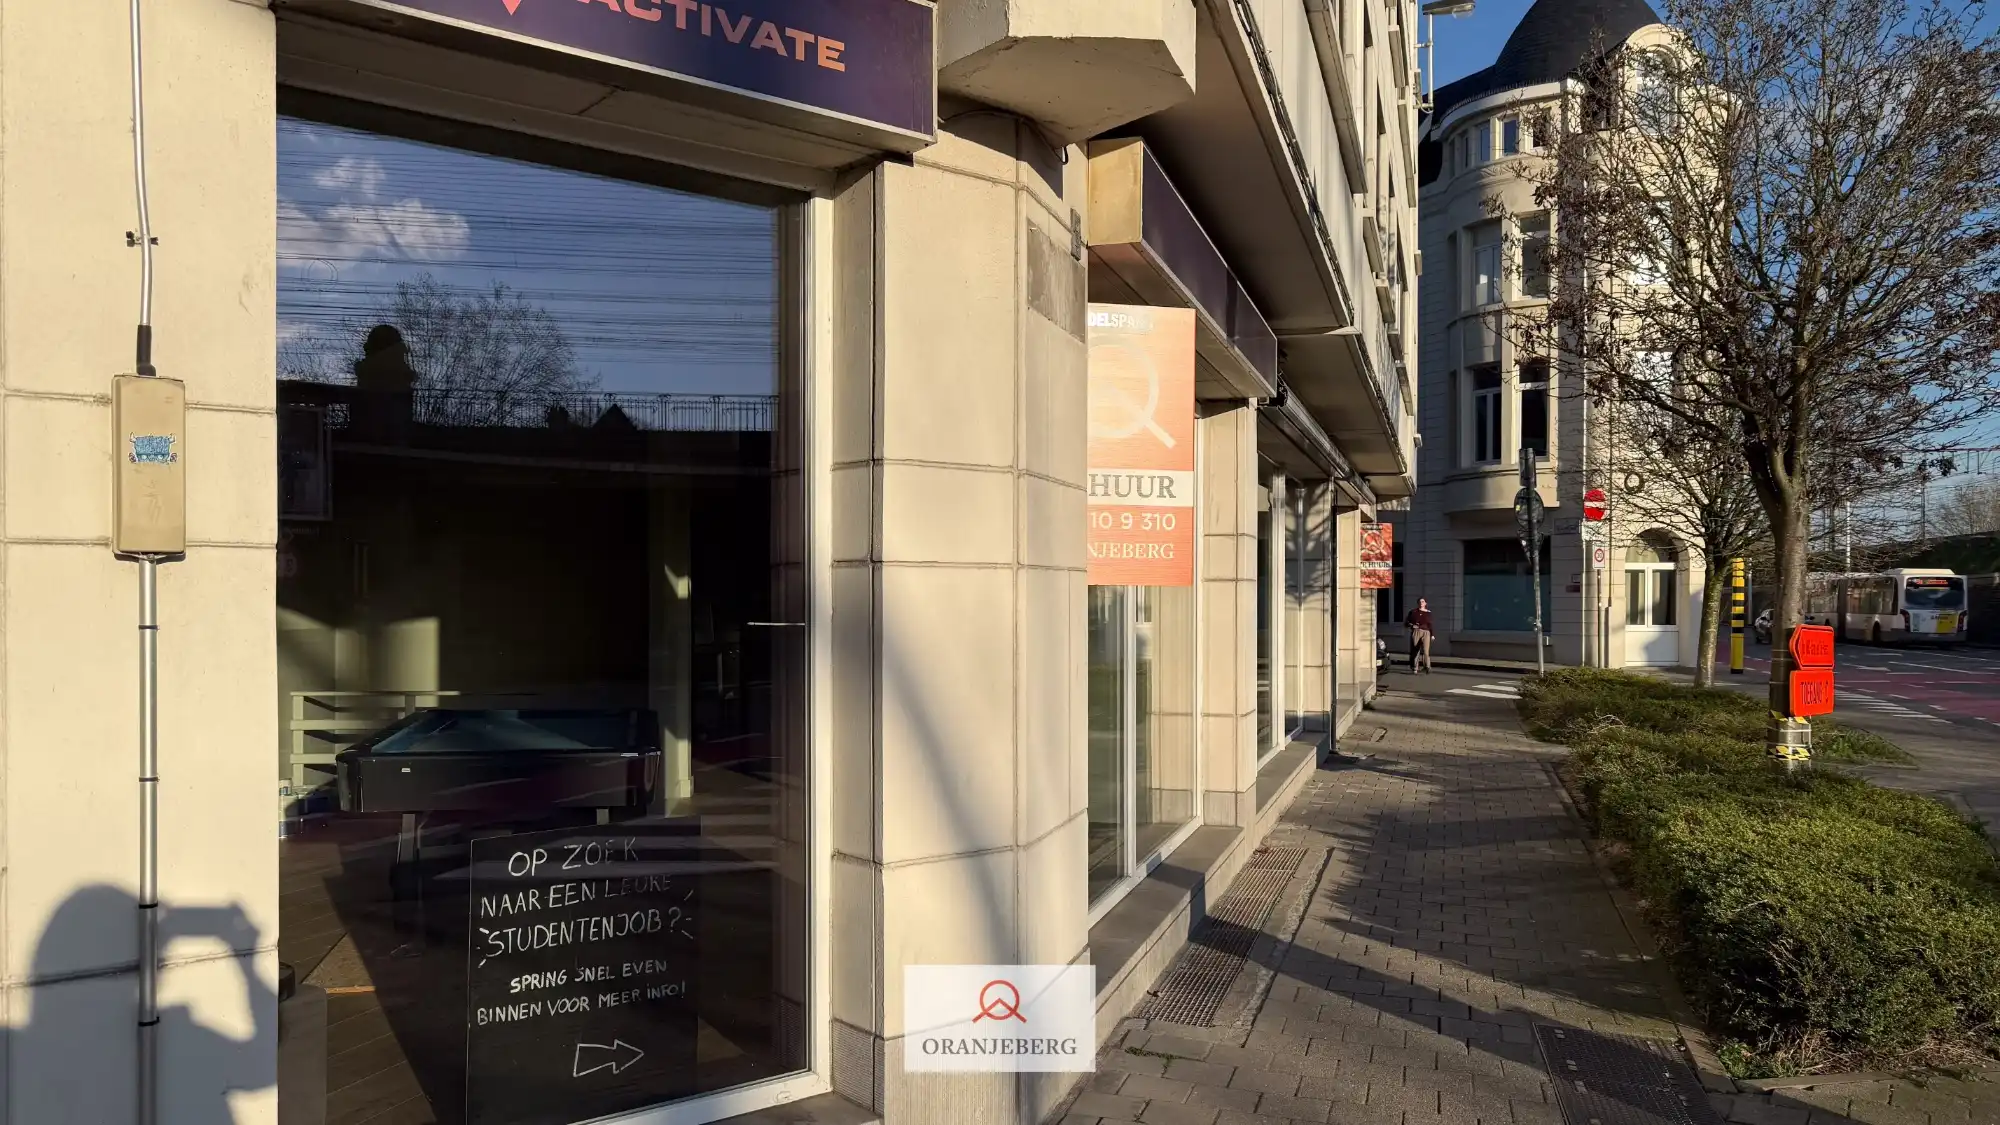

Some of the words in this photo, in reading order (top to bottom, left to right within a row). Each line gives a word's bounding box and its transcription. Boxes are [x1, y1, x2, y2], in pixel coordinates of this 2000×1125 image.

[1088, 474, 1177, 499] HUUR
[1120, 512, 1133, 530] 9
[1141, 512, 1176, 531] 310
[508, 848, 548, 876] OP
[562, 837, 638, 869] ZOEK
[480, 889, 541, 919] NAAR
[548, 882, 596, 909] EEN
[604, 874, 672, 898] LEUKE
[574, 963, 616, 982] SNEL
[622, 959, 667, 977] EVEN
[477, 1001, 542, 1026] BINNEN
[547, 995, 590, 1017] VOOR
[598, 987, 641, 1009] MEER
